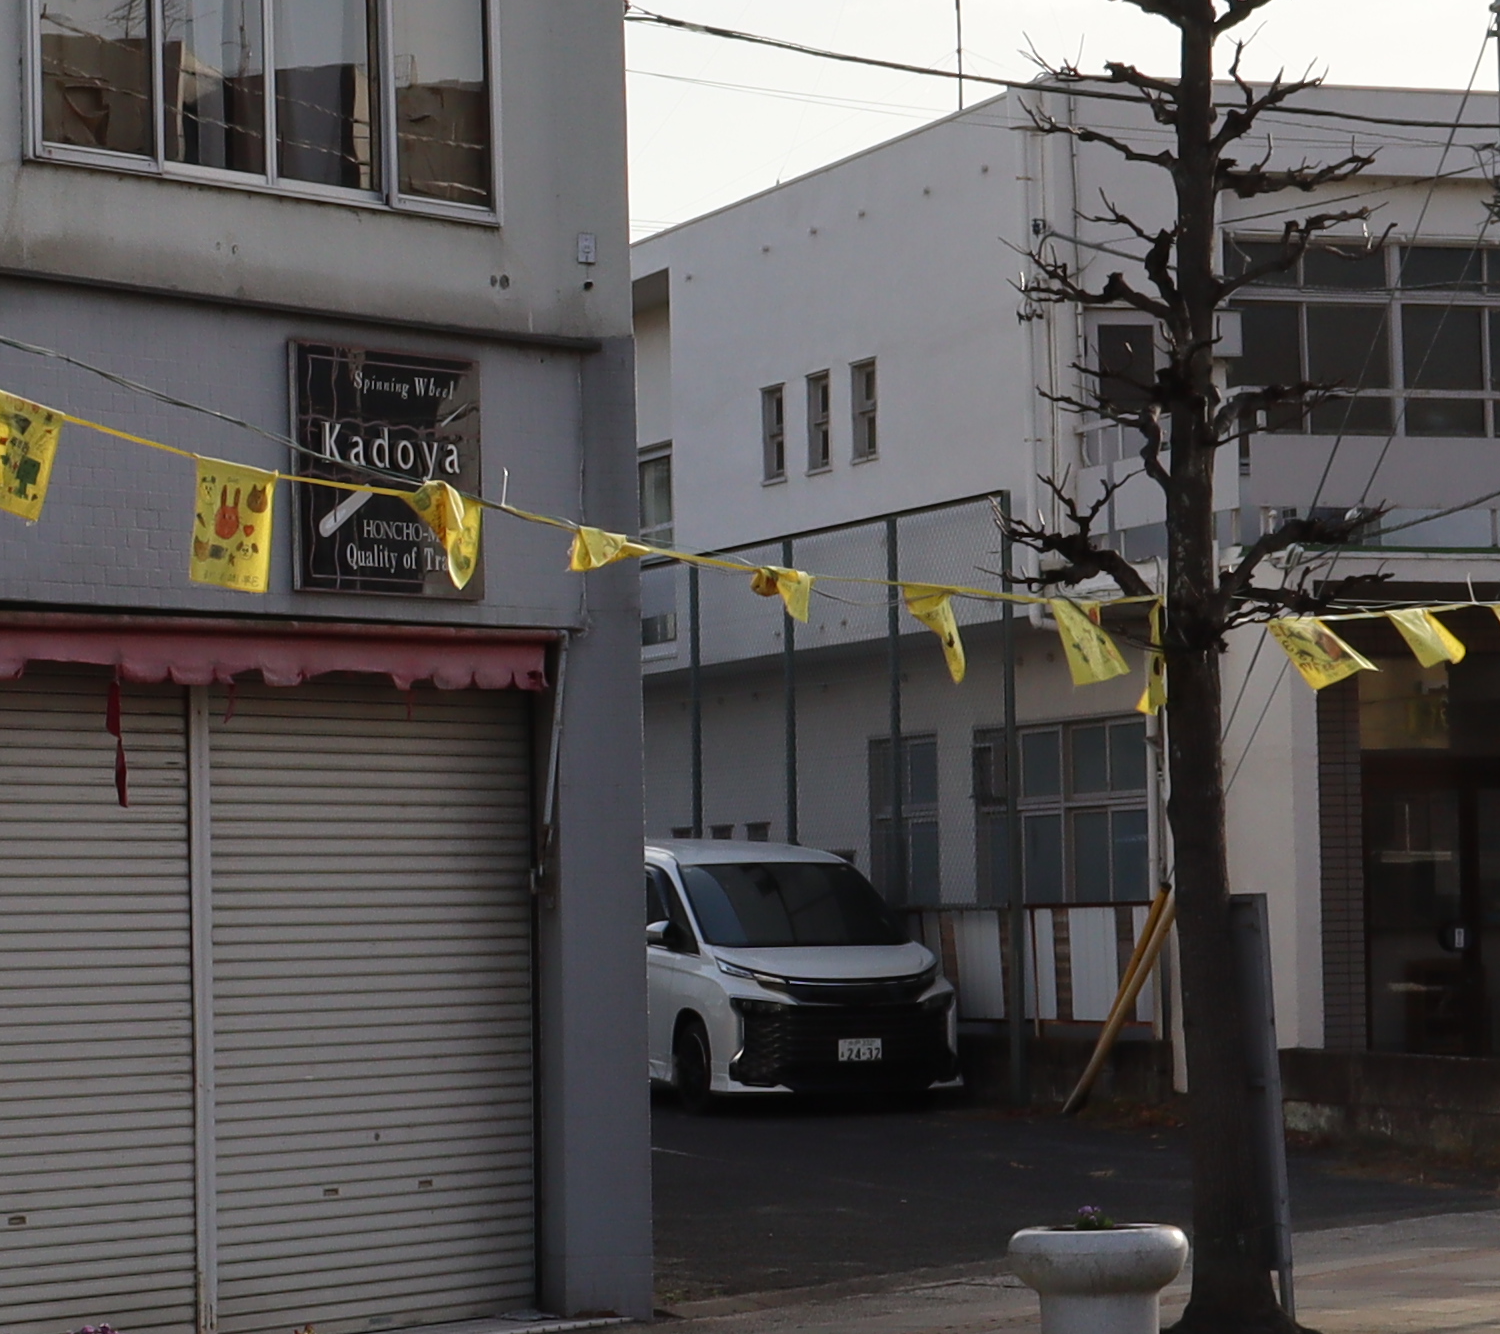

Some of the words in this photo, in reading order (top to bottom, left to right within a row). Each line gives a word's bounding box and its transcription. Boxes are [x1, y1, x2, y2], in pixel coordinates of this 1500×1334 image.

[354, 370, 410, 399] Spinning
[414, 376, 455, 400] Wheel
[321, 421, 460, 481] Kadoya
[363, 519, 440, 543] HONCHO-M
[346, 543, 398, 573] Quality
[403, 547, 419, 574] of
[424, 547, 448, 572] Tra
